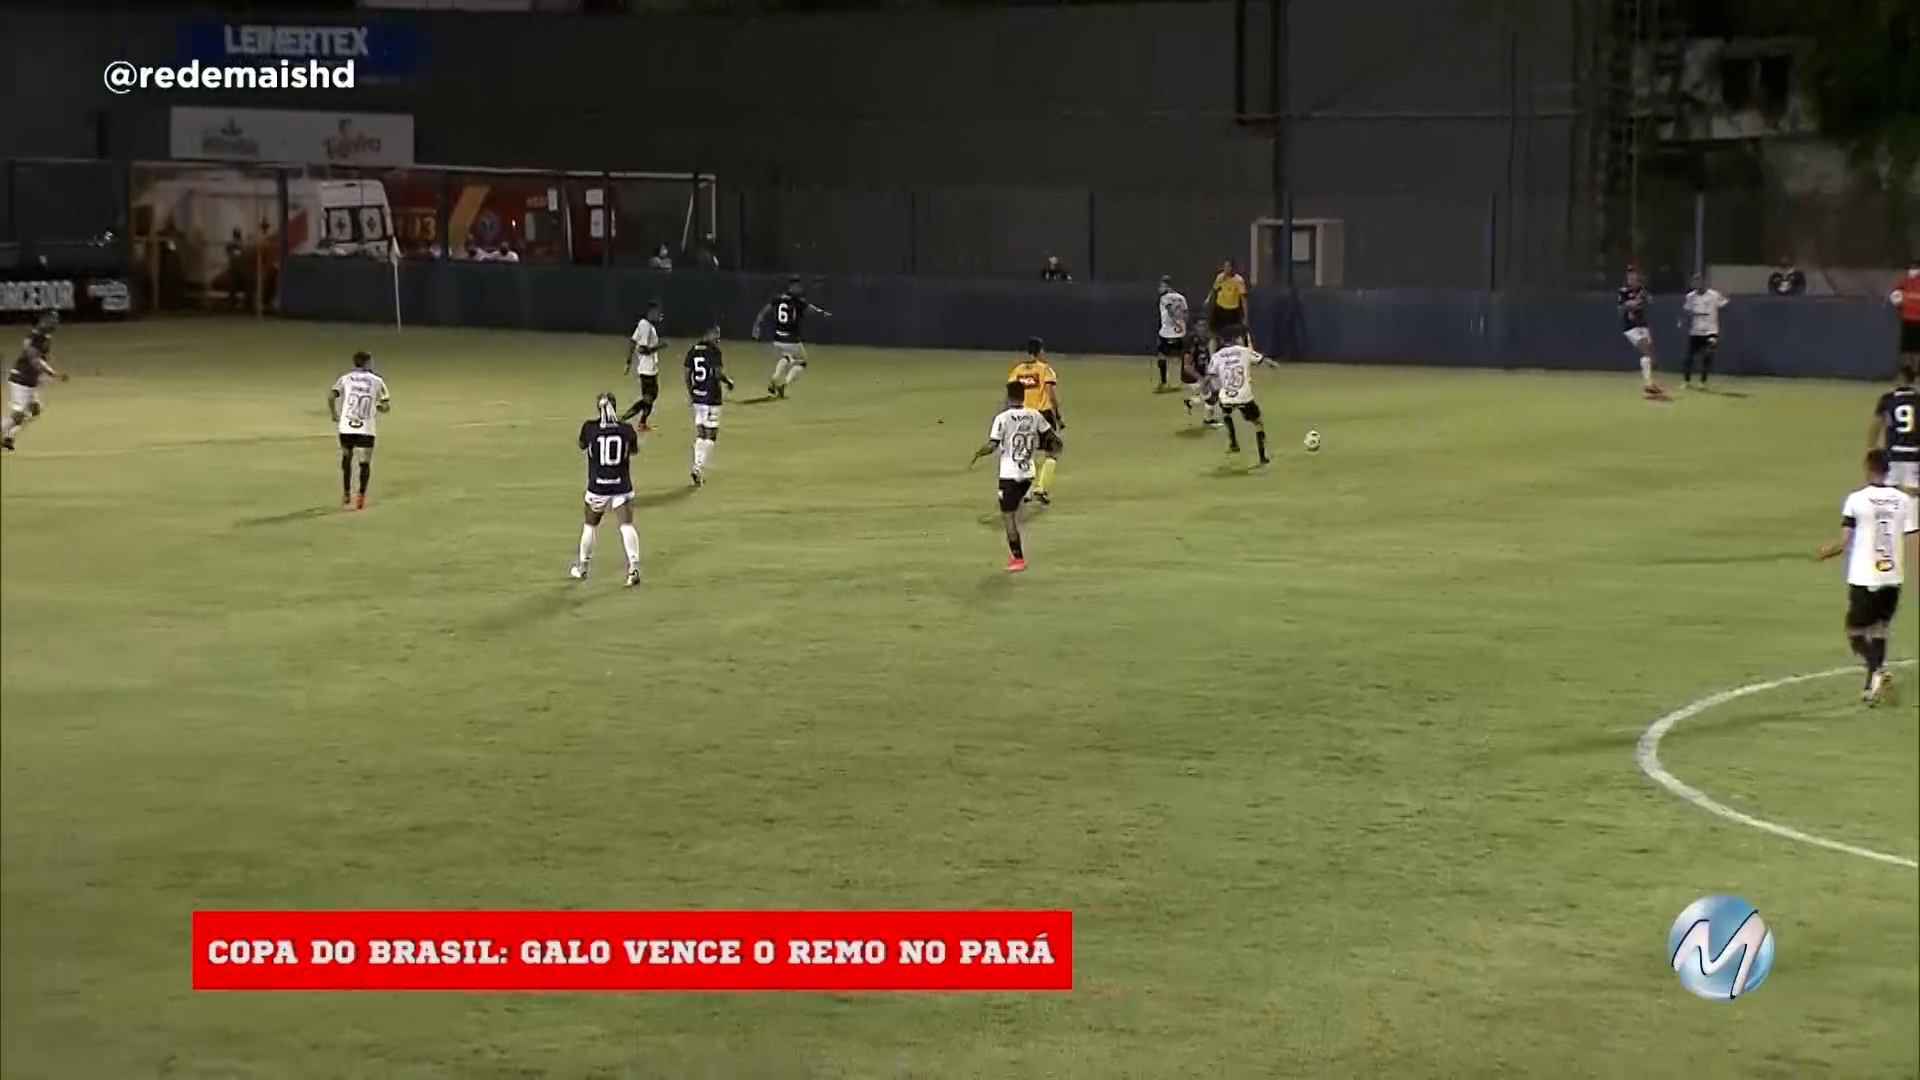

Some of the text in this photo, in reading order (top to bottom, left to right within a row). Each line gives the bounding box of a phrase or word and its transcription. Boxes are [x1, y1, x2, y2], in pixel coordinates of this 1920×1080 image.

[777, 302, 790, 324] 6
[693, 356, 708, 382] 5
[1894, 404, 1915, 433] 9
[596, 434, 623, 467] 10
